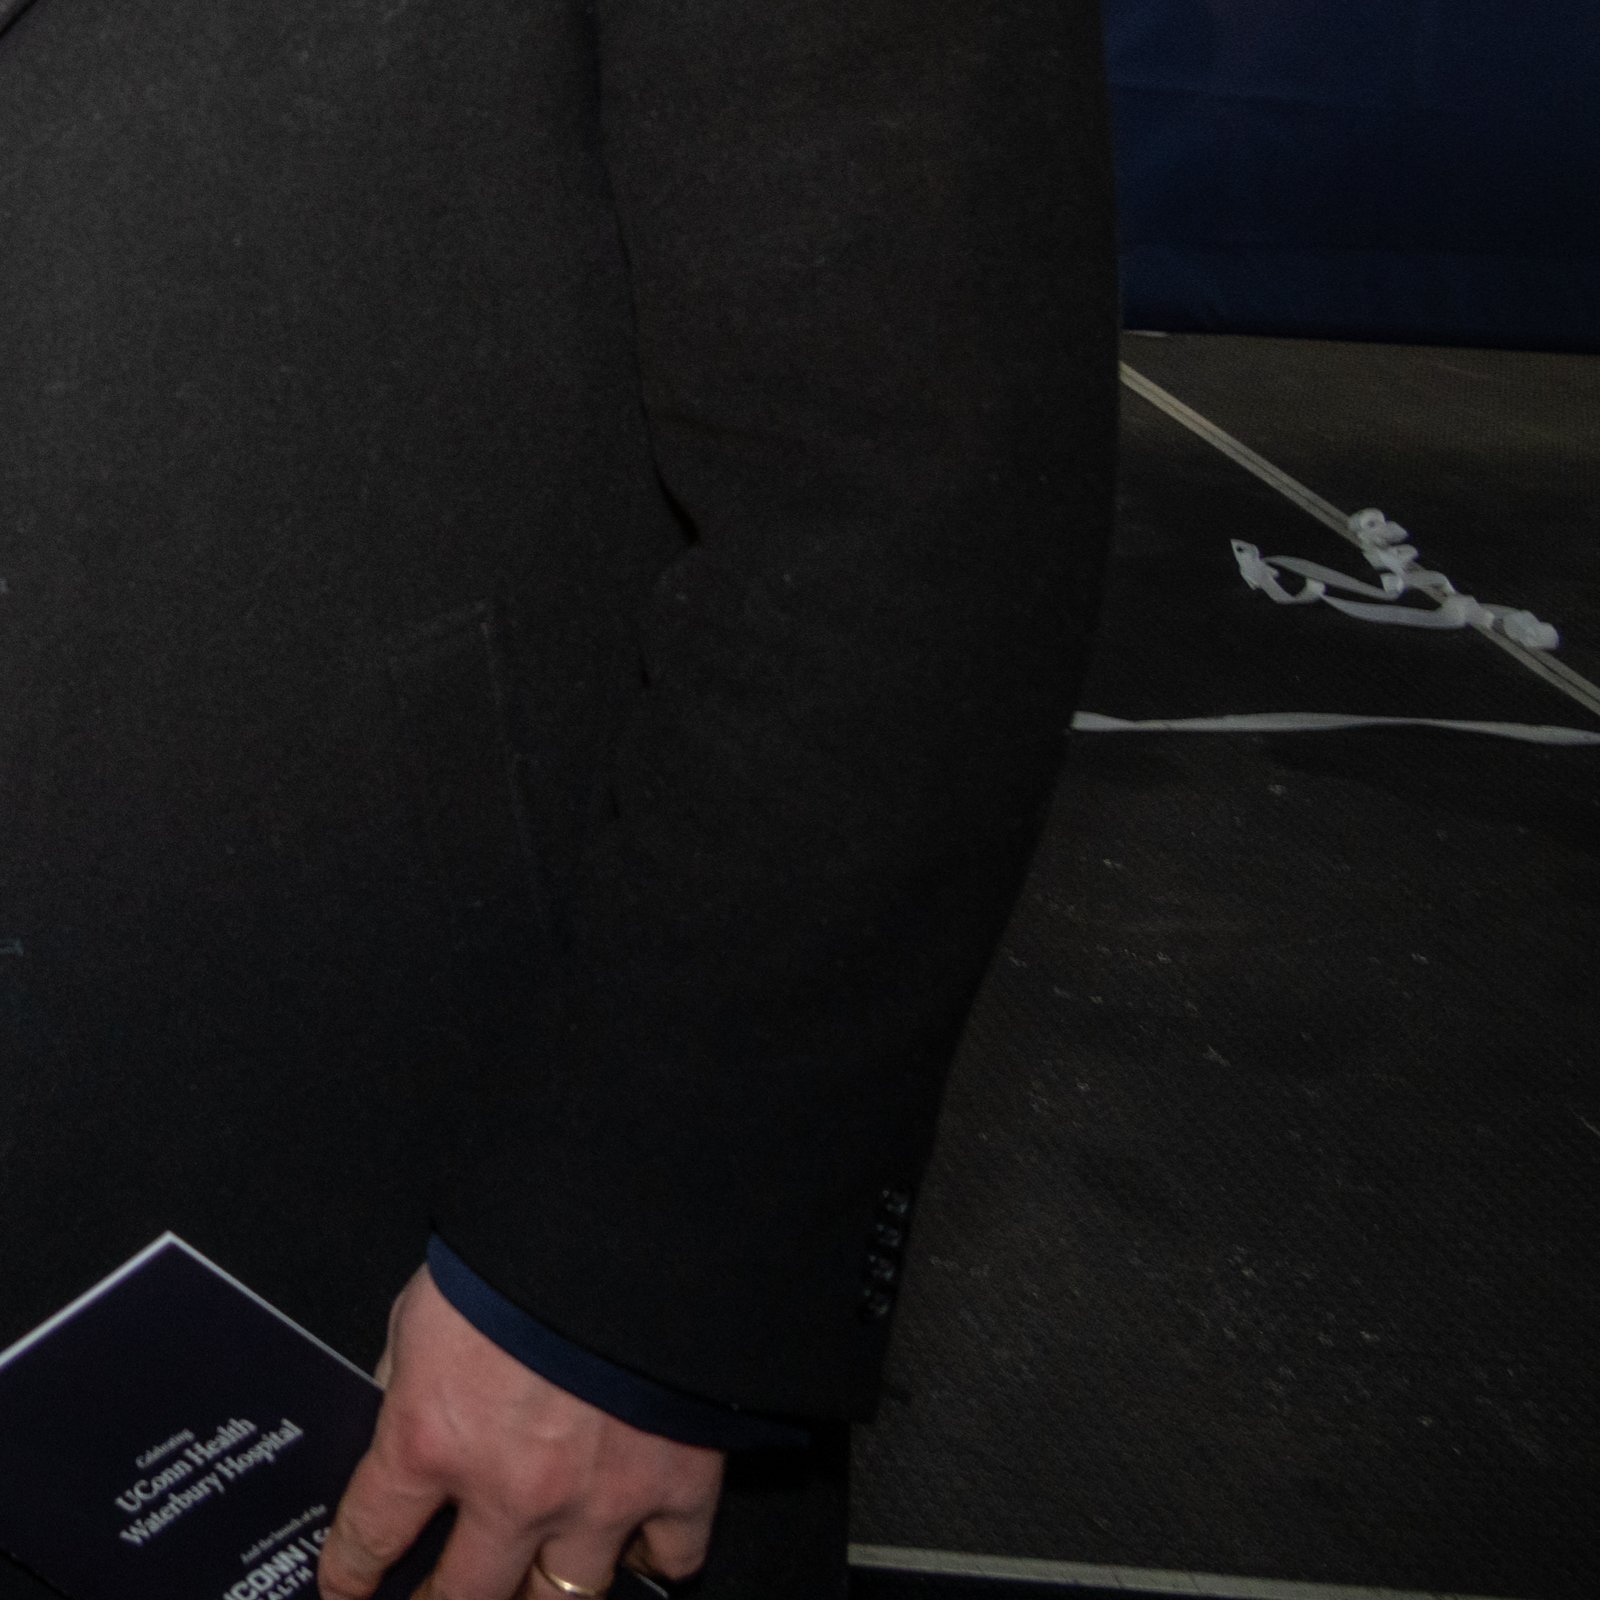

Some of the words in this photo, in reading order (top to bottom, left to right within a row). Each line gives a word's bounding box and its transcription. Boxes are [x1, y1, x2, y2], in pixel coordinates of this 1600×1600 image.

[115, 1459, 194, 1513] UConn
[183, 1417, 257, 1467] Health
[119, 1471, 226, 1545] Waterbury
[213, 1417, 304, 1480] Hospital
